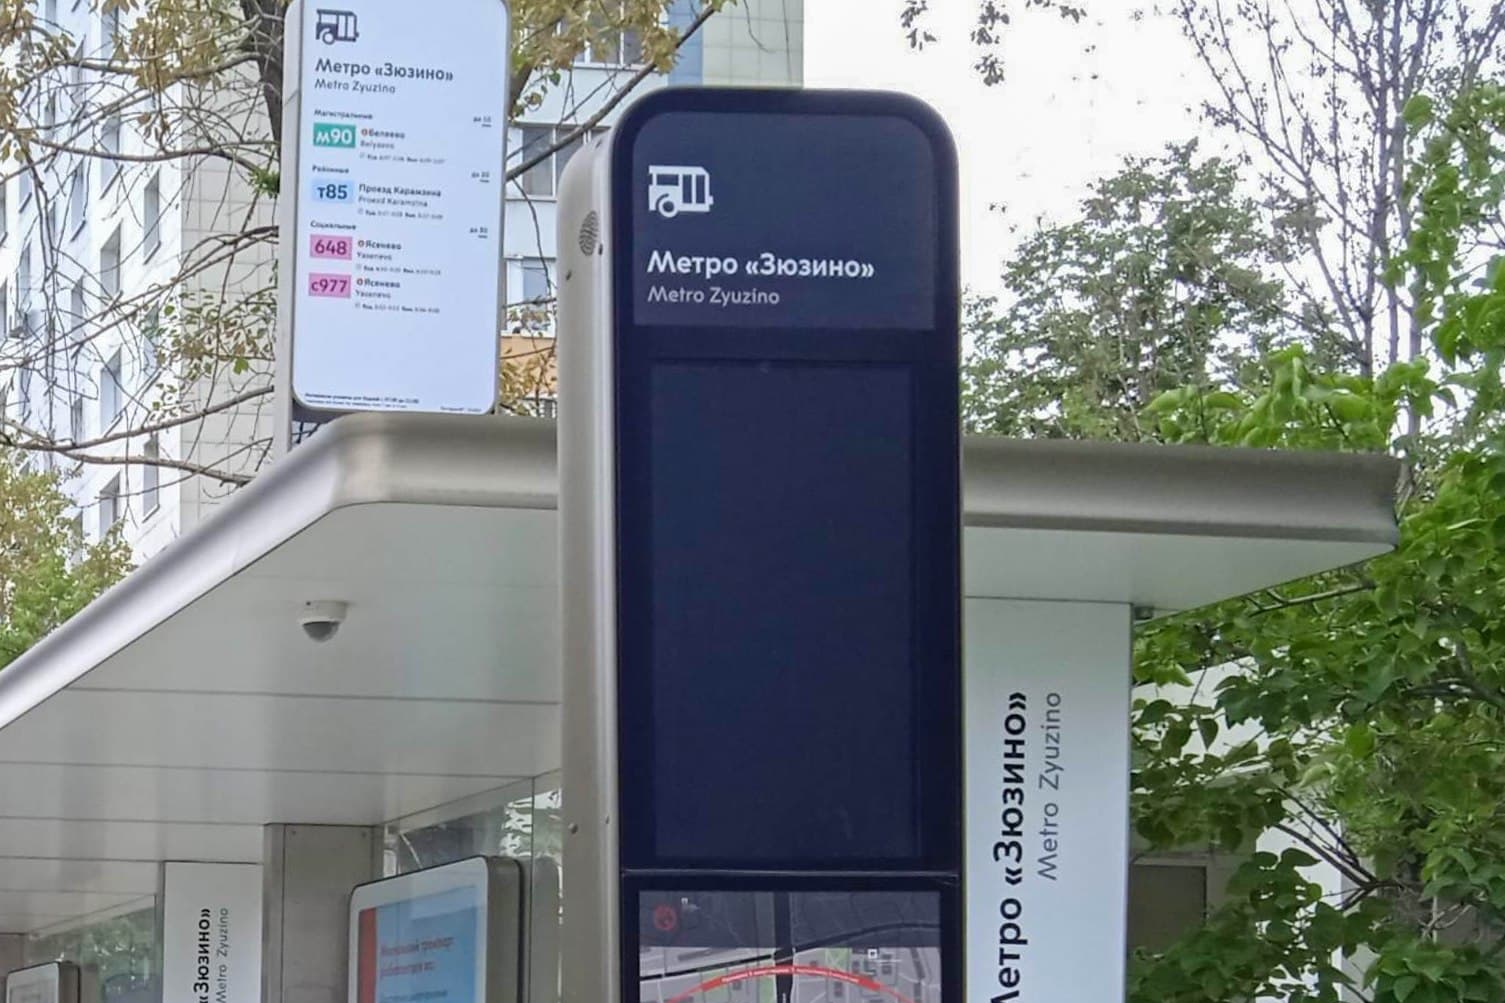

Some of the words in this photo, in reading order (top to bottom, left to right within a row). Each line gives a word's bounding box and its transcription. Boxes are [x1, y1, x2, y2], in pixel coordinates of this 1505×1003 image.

[314, 78, 349, 91] Metro
[352, 80, 396, 94] Zyuzino
[315, 58, 370, 77] Метро
[375, 63, 453, 81] «Зюзино»
[315, 239, 348, 255] 648
[647, 250, 737, 279] Метро
[745, 253, 875, 278] «Зюзино»
[647, 286, 705, 304] Metro
[709, 287, 780, 307] Zyuzino
[1039, 692, 1064, 790] Zyuzino
[994, 691, 1027, 886] «Зюзино»
[1037, 803, 1059, 881] Metro
[216, 907, 229, 957] Zyuzino
[216, 964, 228, 1003] Metro
